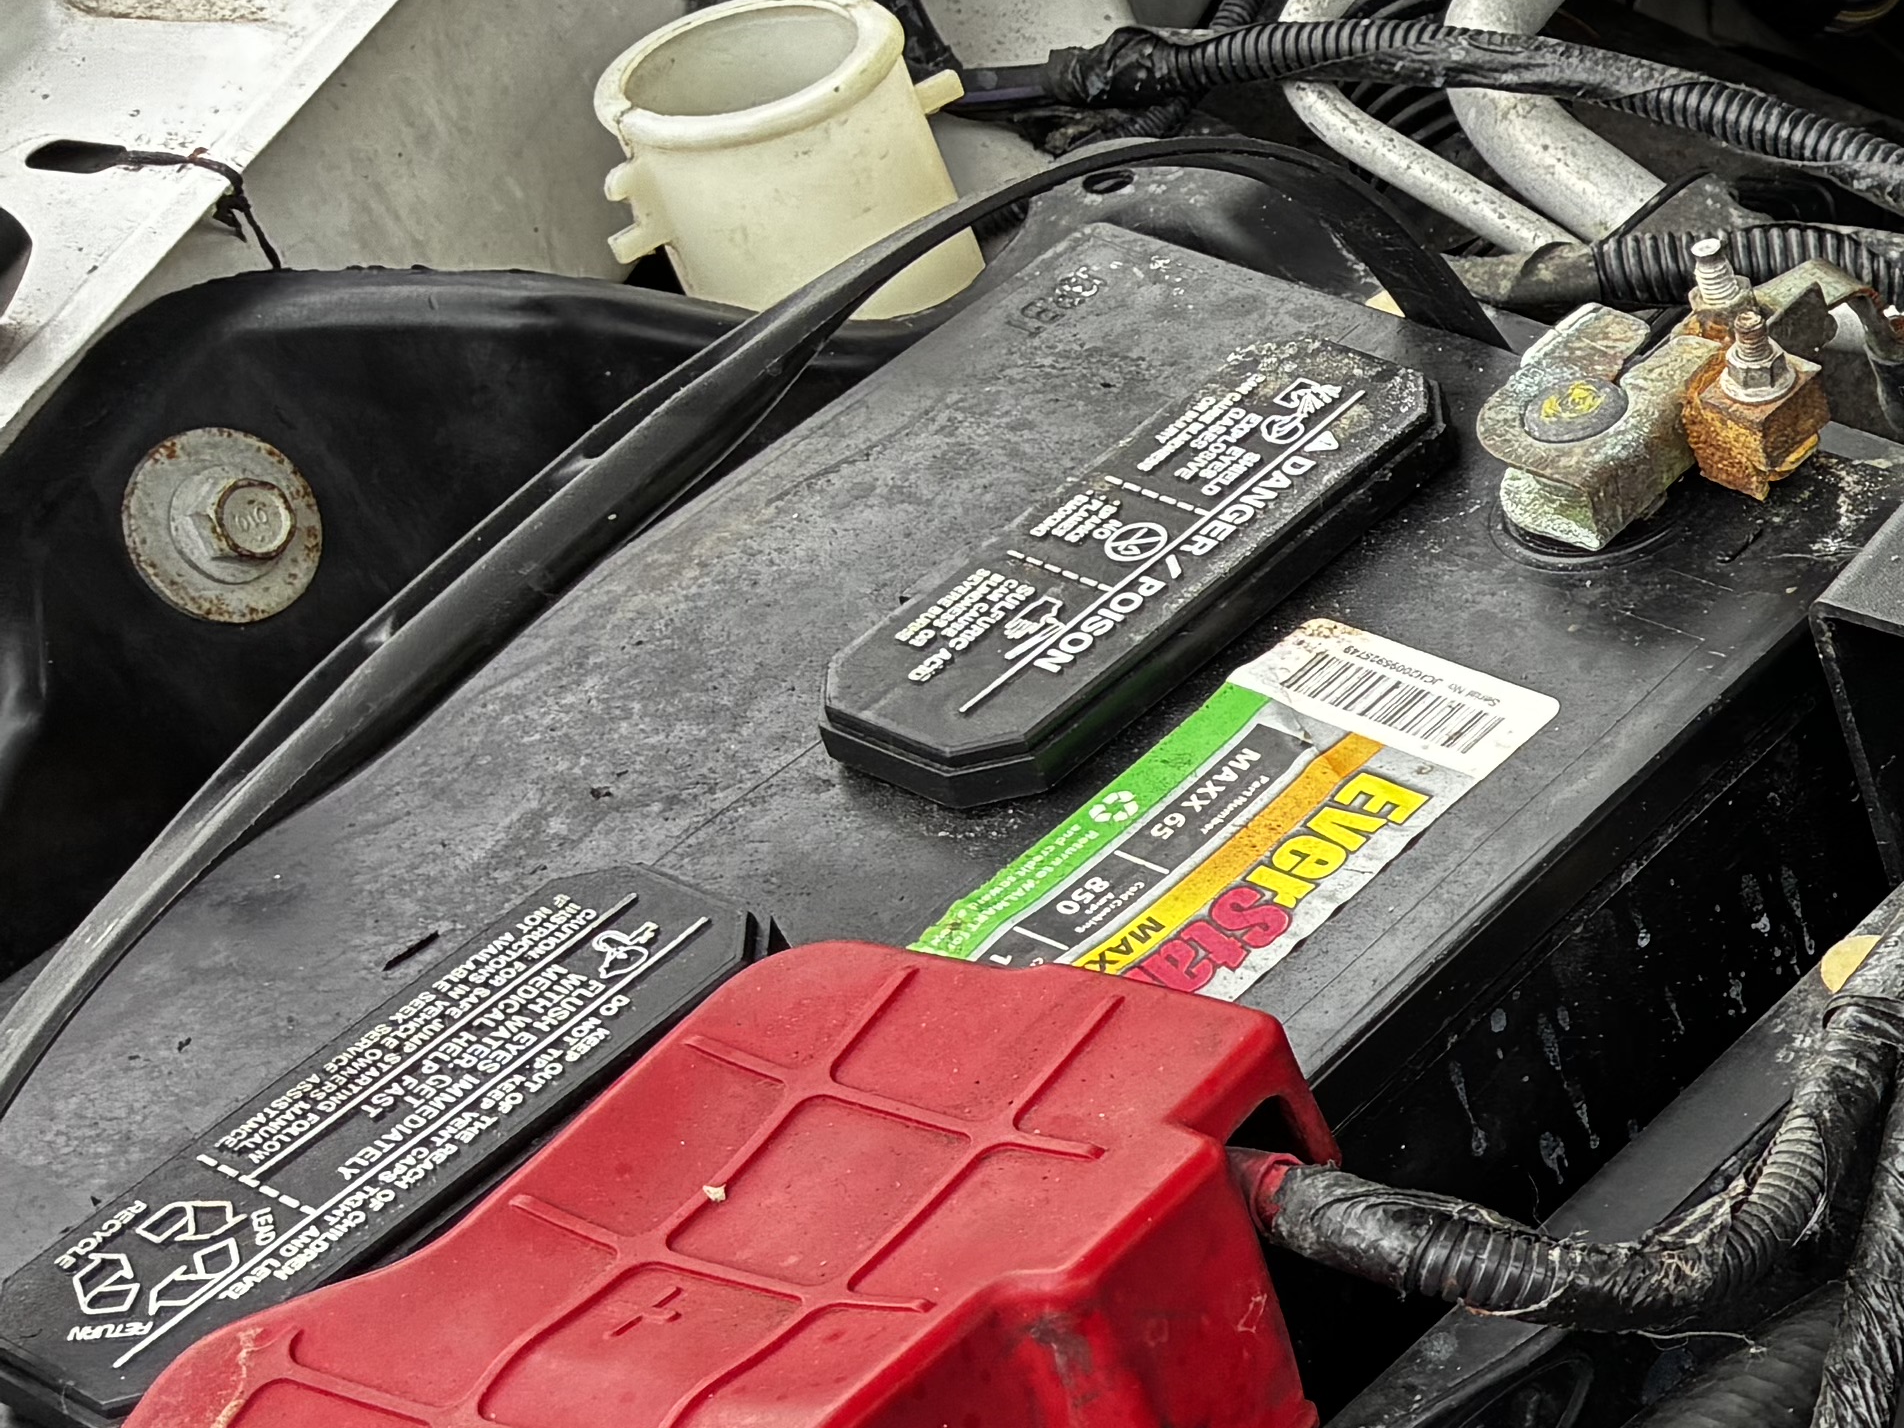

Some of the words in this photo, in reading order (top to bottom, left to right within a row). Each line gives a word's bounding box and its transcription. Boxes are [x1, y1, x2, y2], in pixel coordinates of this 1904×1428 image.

[1189, 394, 1219, 413] OR
[1170, 411, 1266, 481] EXPLOSIVE
[1184, 405, 1249, 451] GASES
[1195, 444, 1247, 480] EYES
[1196, 450, 1264, 498] SHIELD
[1026, 492, 1090, 537] SMOKING
[1047, 497, 1105, 538] FLAMES
[1061, 503, 1119, 544] SPARKS
[1178, 453, 1317, 557] DANGER
[1087, 517, 1125, 541] NO
[929, 572, 1007, 629] BLINDNESS
[934, 567, 993, 608] SEVERE
[983, 577, 1021, 602] CAN
[891, 604, 945, 642] BURNS
[938, 600, 992, 638] CAUSE
[943, 582, 1039, 652] SULFURIC
[1030, 573, 1169, 675] POISON
[905, 627, 939, 648] OR
[902, 646, 959, 684] ACID
[1172, 746, 1269, 813] MAXX
[1236, 774, 1272, 798] Part
[1049, 823, 1087, 847] and
[1143, 810, 1194, 840] 65
[1194, 795, 1249, 835] Number
[1010, 844, 1060, 878] credit
[1045, 828, 1102, 868] Return
[1030, 864, 1058, 880] to
[1115, 880, 1148, 901] Cold
[546, 893, 574, 908] IF
[960, 876, 1042, 933] WALMART
[1048, 874, 1115, 916] 850
[1080, 890, 1118, 916] Amps
[510, 906, 556, 933] NOT
[518, 907, 604, 962] CAUTION:
[1071, 897, 1126, 934] Cranking
[429, 931, 523, 992] AVAILABLE
[462, 902, 588, 985] INSTRUCTIONS
[444, 983, 473, 1000] IN
[485, 960, 530, 987] FOR
[522, 971, 591, 1014] WITH
[386, 990, 440, 1025] SEEK
[441, 985, 495, 1018] SAFE
[469, 963, 574, 1031] MEDICAL
[528, 978, 611, 1032] FLUSH
[593, 993, 634, 1018] DO
[375, 997, 454, 1049] VEHICLE
[394, 1017, 451, 1053] JUMP
[444, 1013, 535, 1073] WATER.
[556, 1015, 605, 1046] NOT
[319, 1022, 396, 1073] SERVICE
[412, 1030, 482, 1075] HELP
[471, 1029, 541, 1075] EYES
[522, 1046, 565, 1073] TIP.
[557, 1026, 614, 1063] KEEP
[305, 1046, 387, 1102] OWNERS
[313, 1051, 405, 1113] STARTING
[397, 1070, 456, 1109] GET
[472, 1072, 529, 1110] KEEP
[520, 1060, 568, 1091] OUT
[210, 1072, 327, 1152] ASSISTANCE.
[357, 1073, 423, 1117] FAST
[490, 1090, 528, 1114] OF
[231, 1099, 313, 1156] MANUAL.
[244, 1110, 322, 1165] FOLLOW
[329, 1073, 484, 1181] IMMEDIATELY
[424, 1108, 481, 1147] VENT
[452, 1114, 497, 1144] THE
[374, 1144, 433, 1185] CAPS
[391, 1141, 461, 1190] REACH
[319, 1181, 382, 1226] TIGHT
[363, 1187, 398, 1211] OF
[49, 1198, 152, 1271] RECYCLE
[249, 1207, 275, 1245] LEAD
[269, 1208, 371, 1281] CHILDREN
[275, 1223, 325, 1259] AND
[66, 1320, 152, 1341] RETURN
